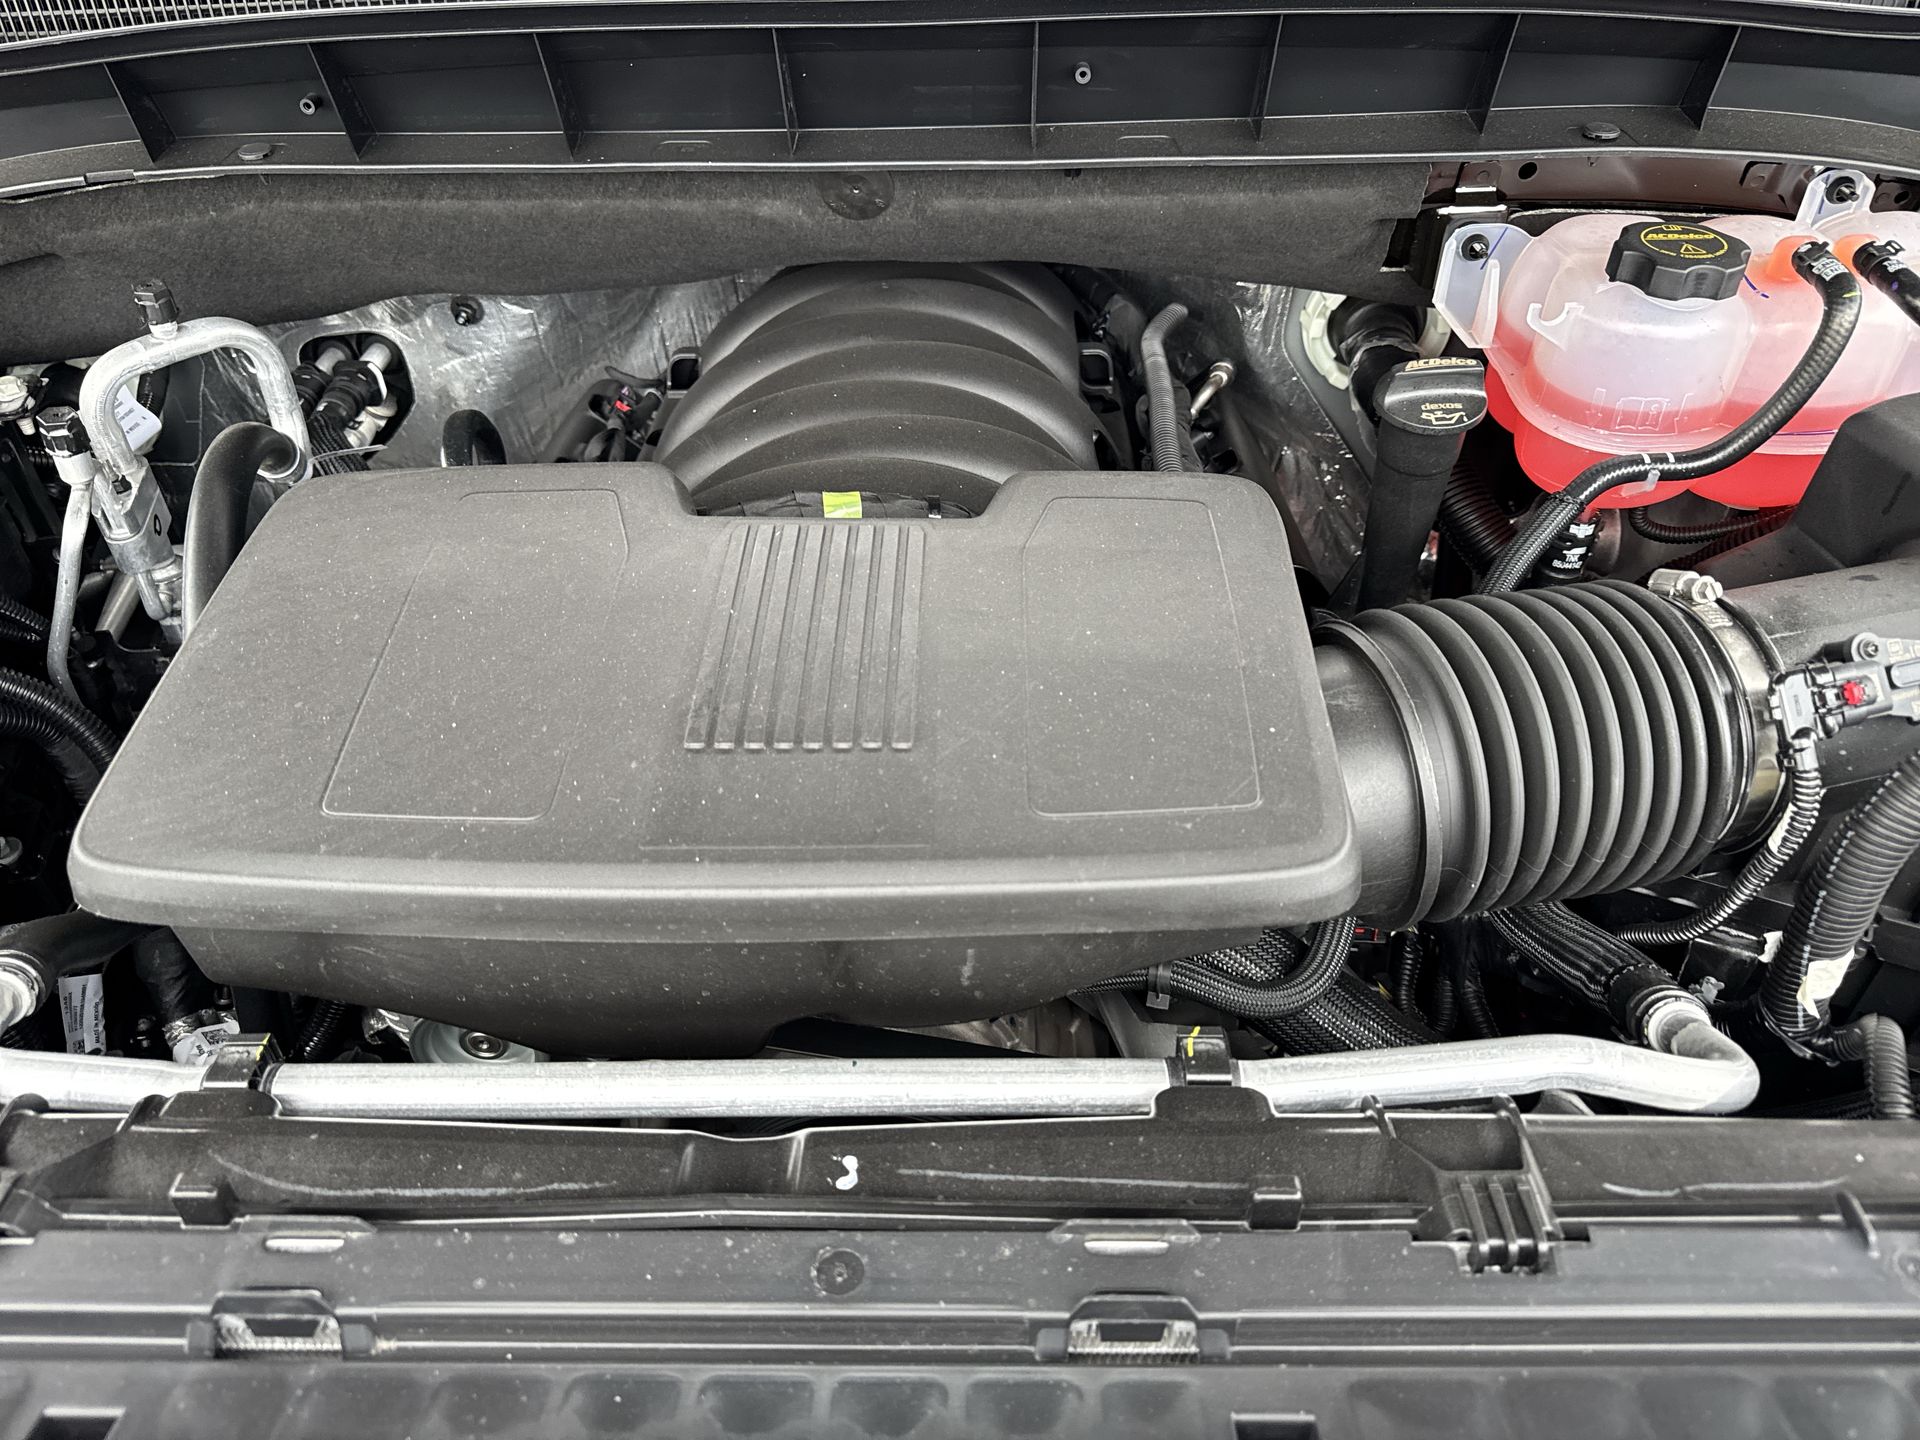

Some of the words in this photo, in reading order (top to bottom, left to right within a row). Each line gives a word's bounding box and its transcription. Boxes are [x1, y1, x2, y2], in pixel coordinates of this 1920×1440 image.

[1644, 232, 1715, 241] ACDelco
[1405, 357, 1477, 371] ACDelco
[1421, 402, 1463, 411] dexos
